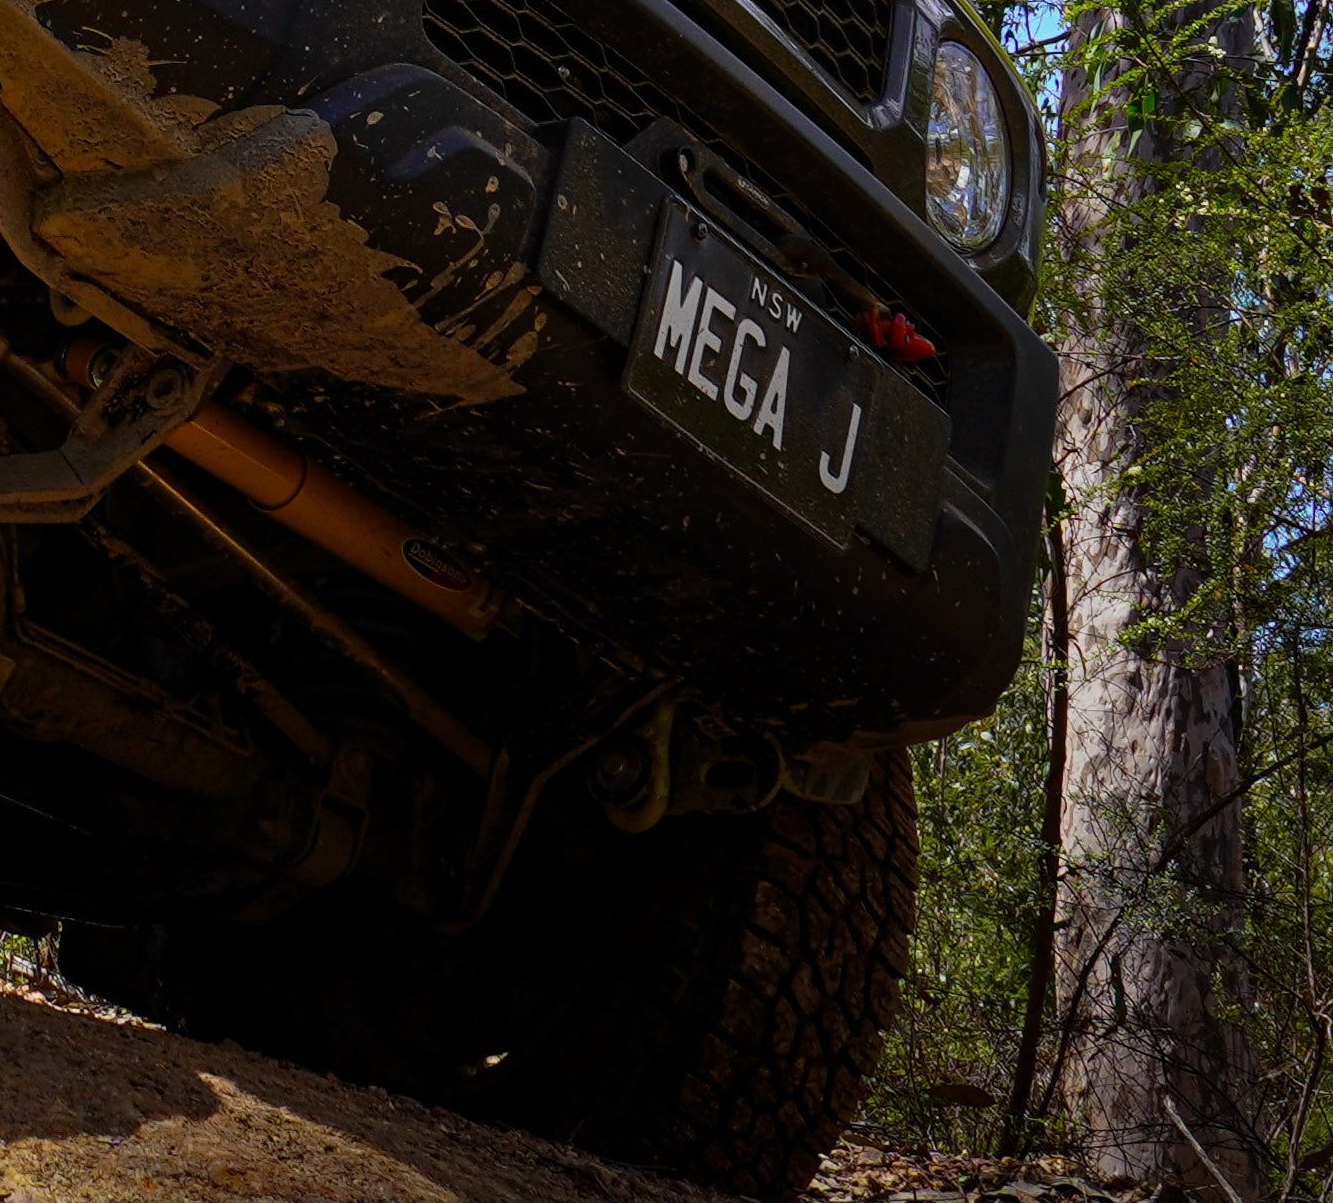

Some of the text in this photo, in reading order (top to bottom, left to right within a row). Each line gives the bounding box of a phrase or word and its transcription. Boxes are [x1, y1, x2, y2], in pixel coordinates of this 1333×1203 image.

[653, 259, 862, 494] MEGA J
[750, 276, 803, 333] NSW
